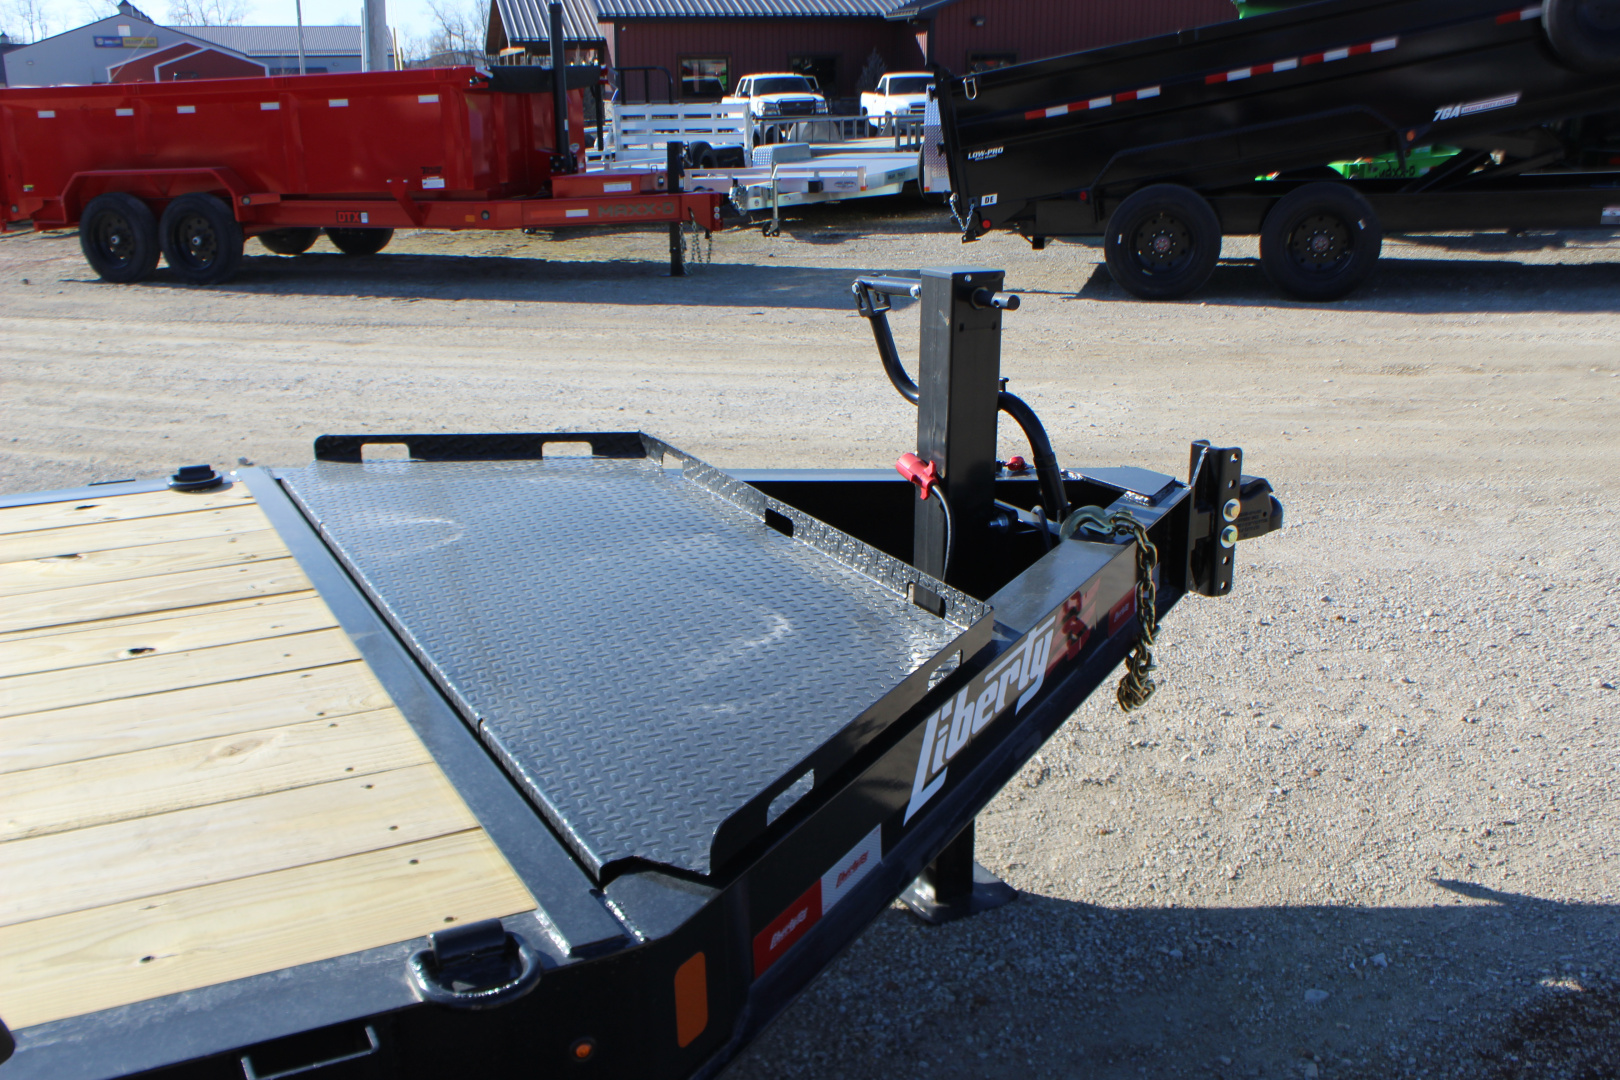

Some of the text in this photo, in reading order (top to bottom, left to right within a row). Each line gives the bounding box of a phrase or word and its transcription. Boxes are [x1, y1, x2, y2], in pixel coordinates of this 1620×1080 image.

[1433, 105, 1462, 122] 7GA
[968, 146, 1004, 160] LOW-PRO
[338, 211, 360, 223] DTX
[598, 202, 674, 217] MAXX-D
[903, 616, 1057, 828] Liberty
